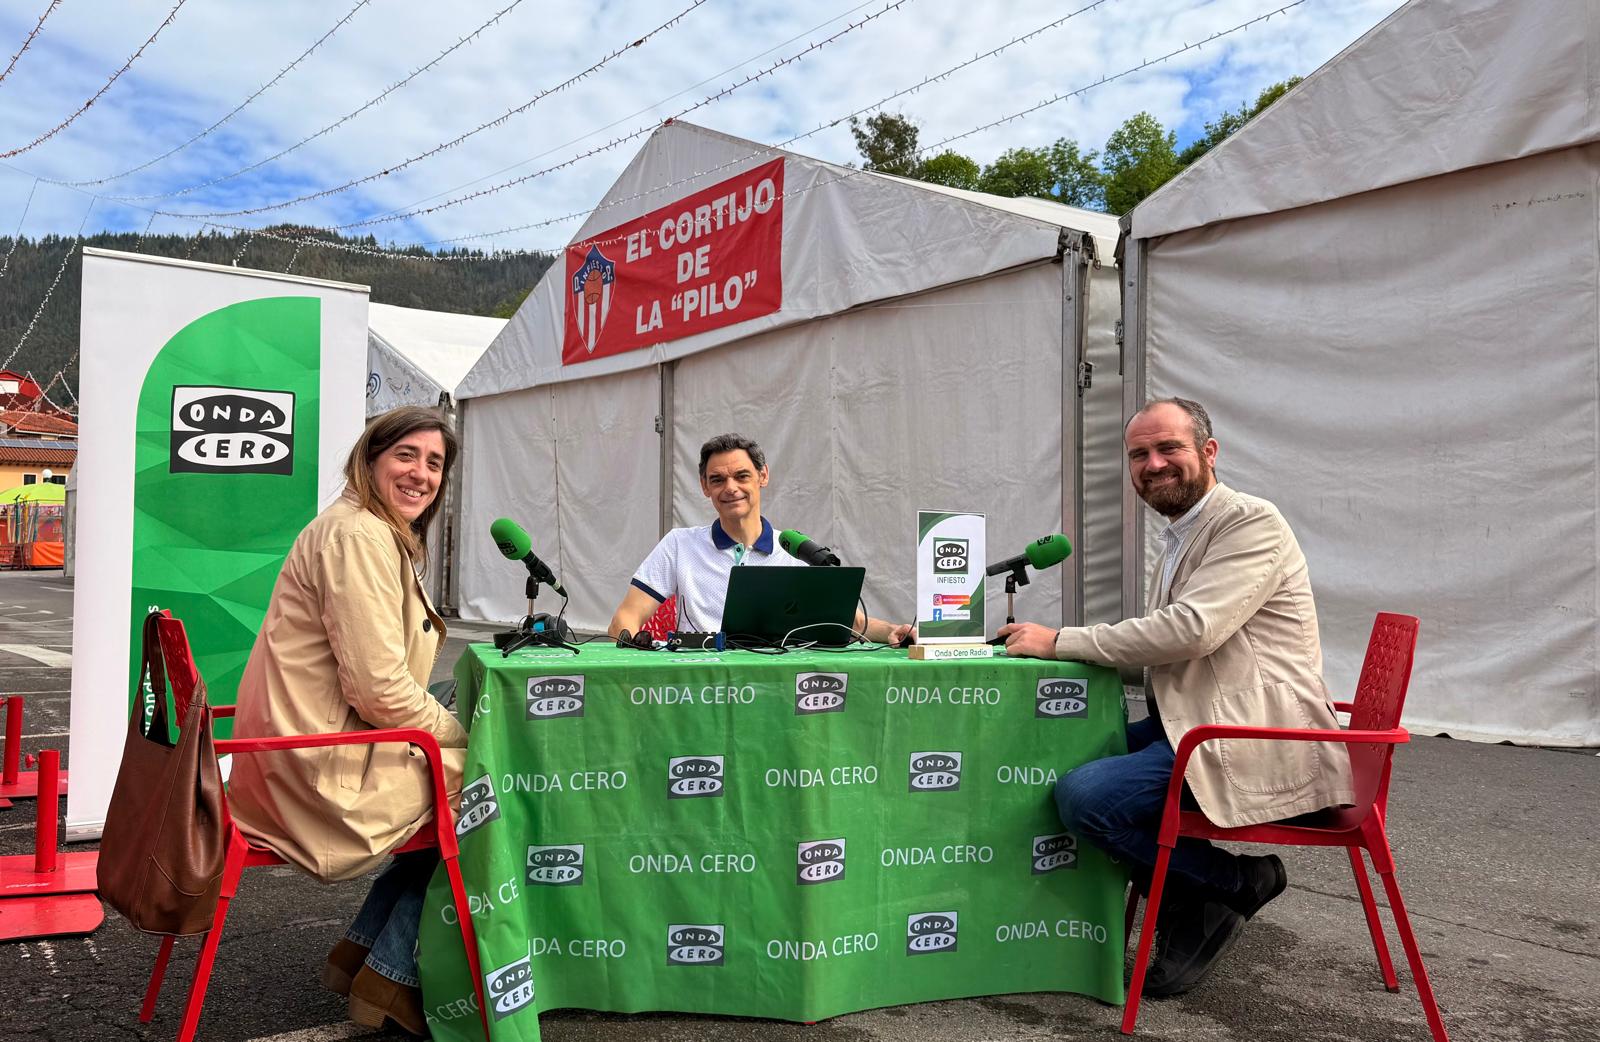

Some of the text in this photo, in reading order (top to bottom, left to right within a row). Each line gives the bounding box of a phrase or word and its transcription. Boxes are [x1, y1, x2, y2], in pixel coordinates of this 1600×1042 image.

[625, 178, 776, 264] EL CORTIJO
[677, 244, 711, 285] DE
[636, 300, 664, 335] LA
[190, 403, 276, 425] ONDA
[194, 438, 276, 459] CERO
[939, 546, 963, 555] ONDA
[940, 559, 963, 567] CERO
[936, 576, 966, 584] INFIESTO
[934, 648, 987, 657] Onda Cero Radio
[533, 682, 577, 695] ONDA
[802, 679, 840, 690] ONDA
[1044, 684, 1081, 696] ONDA
[630, 685, 756, 705] ONDA CERO
[804, 695, 839, 707] CERO
[885, 686, 1001, 705] ONDA CERO
[536, 699, 576, 711] CERO
[1045, 701, 1079, 712] CERO
[676, 763, 717, 774] ONDA
[916, 759, 954, 770] ONDA
[501, 771, 627, 793] ONDA CERO
[765, 766, 878, 788] ONDA CERO
[918, 775, 954, 786] CERO
[996, 765, 1058, 786] ONDA
[678, 780, 716, 792] CERO
[460, 786, 487, 809] NDA
[461, 804, 490, 829] CERO
[1039, 838, 1070, 852] ONDA
[534, 852, 576, 863] ONDA
[805, 846, 840, 860] ONDA
[881, 845, 994, 867] ONDA CERO
[629, 853, 756, 873] ONDA CERO
[1041, 854, 1069, 868] CERO
[536, 868, 575, 880] CERO
[807, 864, 839, 878] CERO
[441, 891, 495, 925] ODA
[913, 919, 951, 931] ONDA
[995, 919, 1107, 944] ONDA CERO
[675, 930, 716, 942] ONDA
[915, 935, 950, 948] CERO
[568, 939, 626, 958] CERO
[677, 948, 716, 960] CERO
[766, 932, 879, 962] ONDA CERO
[502, 983, 534, 1008] CER
